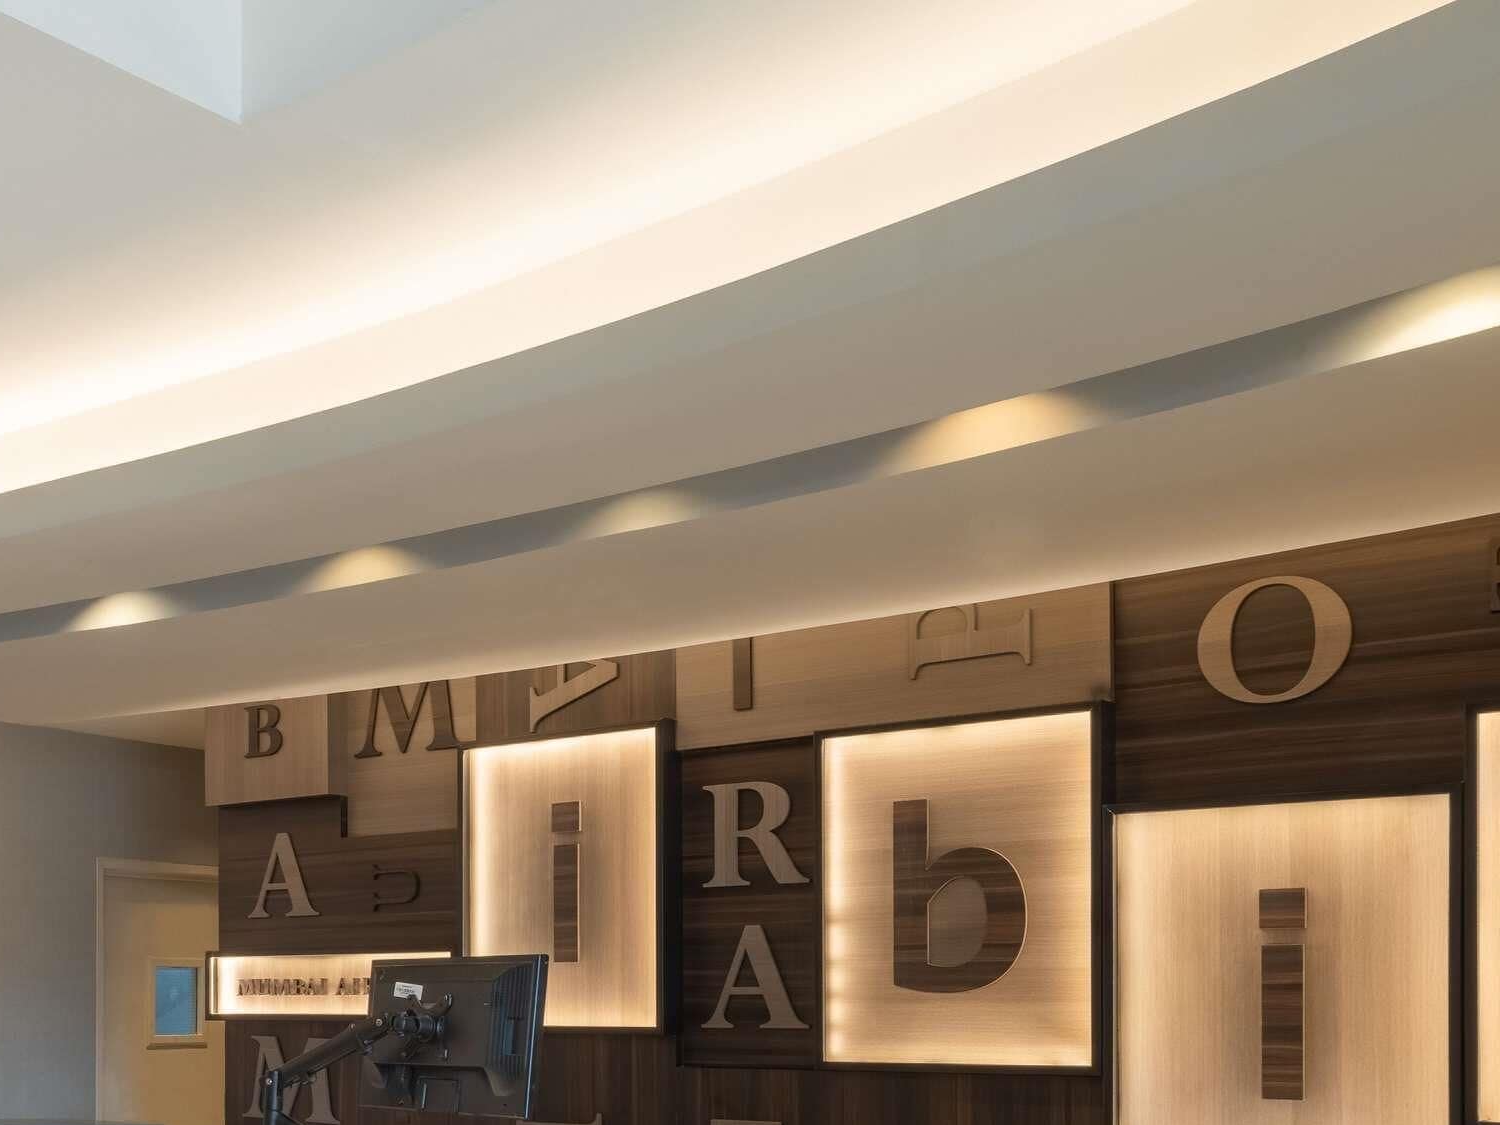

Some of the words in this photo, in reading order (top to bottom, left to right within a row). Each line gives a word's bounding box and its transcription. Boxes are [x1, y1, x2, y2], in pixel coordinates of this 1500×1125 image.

[1197, 575, 1353, 704] O
[243, 703, 284, 759] B
[354, 681, 466, 758] M
[247, 832, 320, 919] A
[702, 781, 810, 888] R
[893, 798, 1028, 994] b
[701, 924, 810, 1029] A
